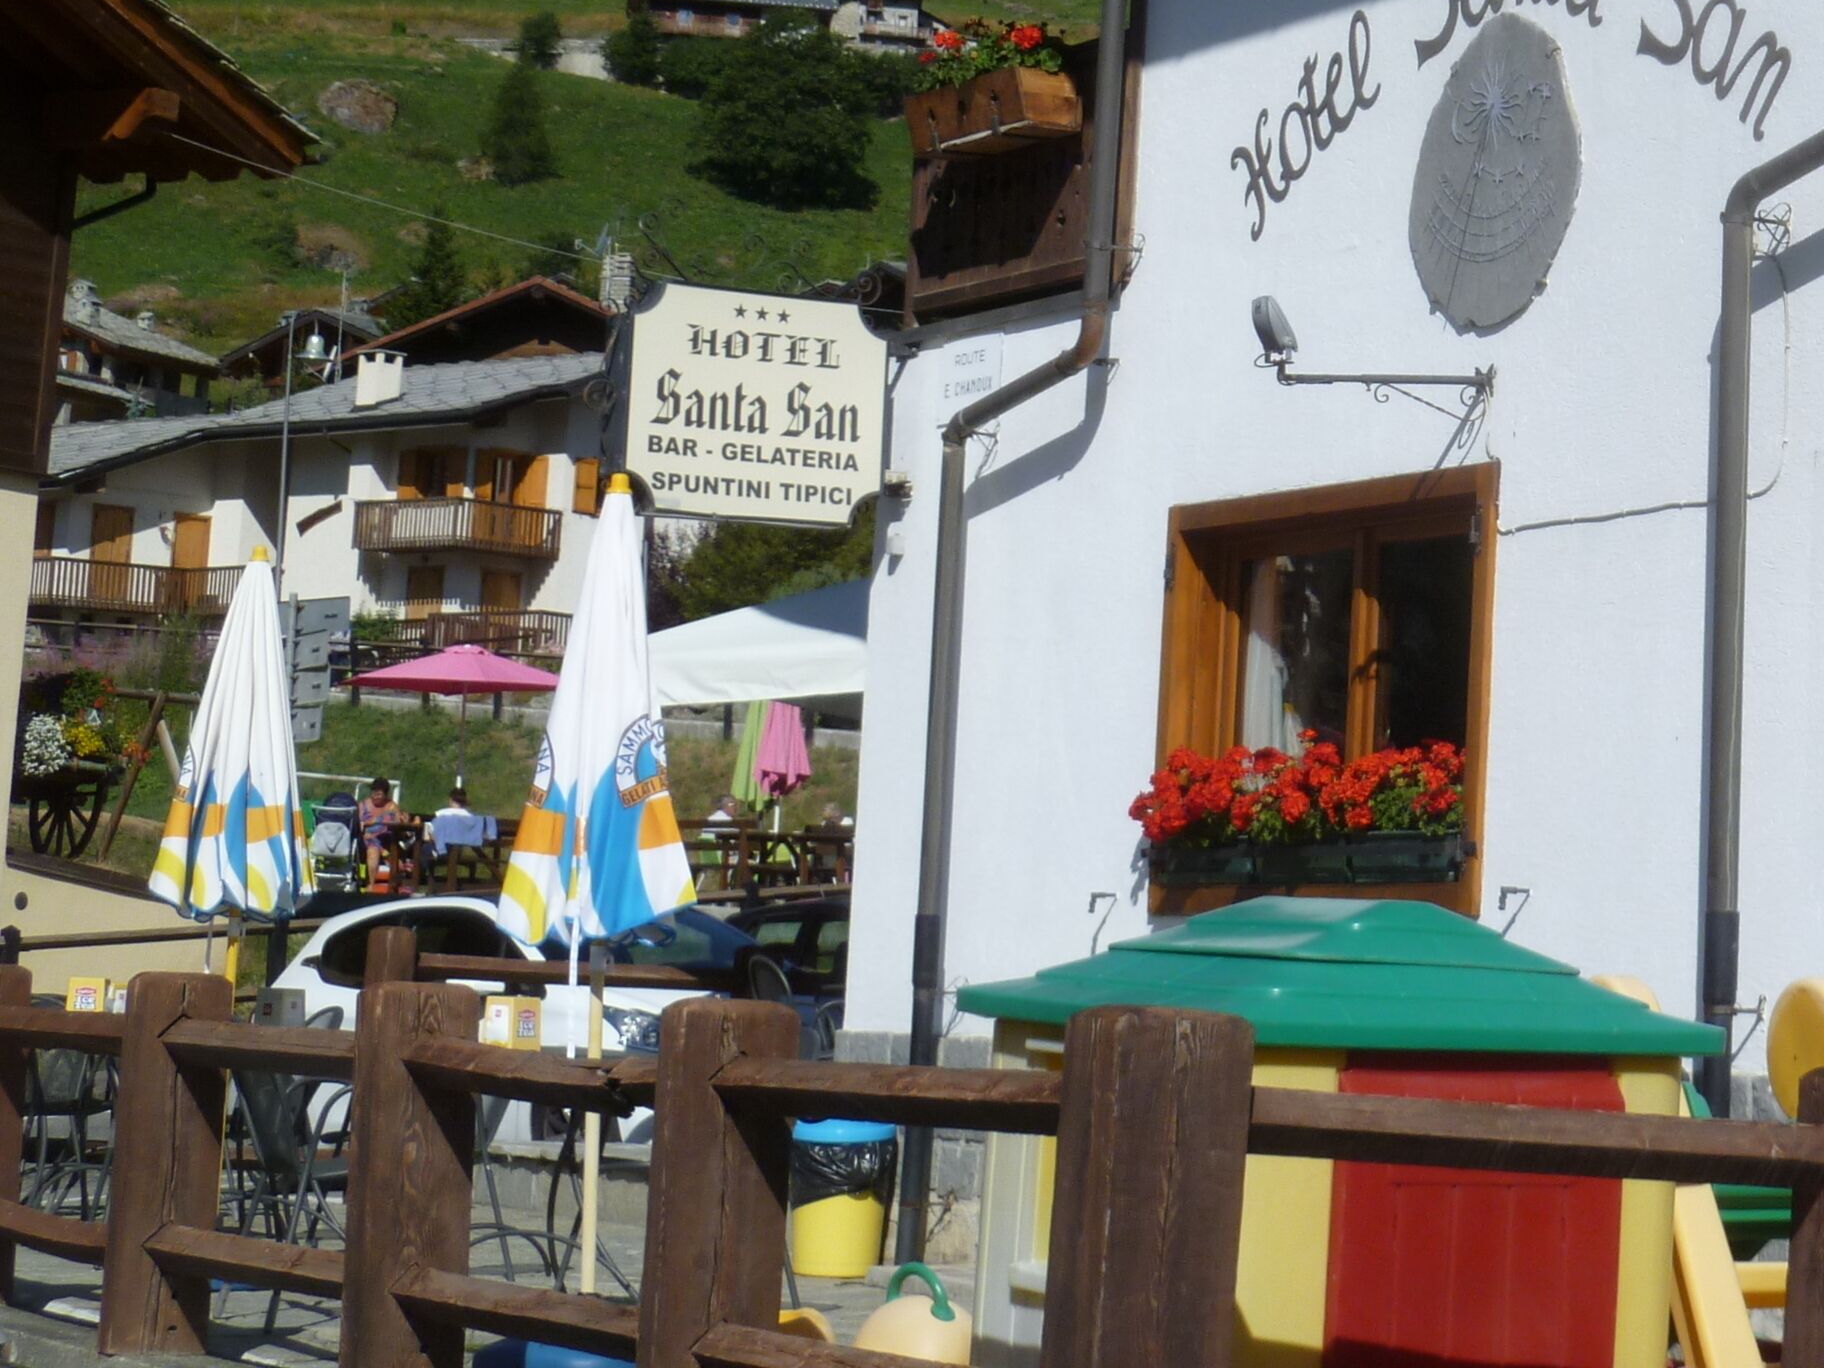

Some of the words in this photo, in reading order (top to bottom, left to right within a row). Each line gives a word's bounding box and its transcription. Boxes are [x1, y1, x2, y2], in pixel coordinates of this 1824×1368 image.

[1231, 10, 1381, 241] Hotel
[686, 323, 841, 369] HOTEL
[955, 349, 985, 366] ROUTE
[650, 368, 768, 434] Santa
[780, 381, 860, 442] San
[647, 435, 697, 457] BAR
[722, 443, 858, 471] GELATERIA
[652, 472, 770, 499] SPUNTINI
[780, 483, 851, 505] TIPICI
